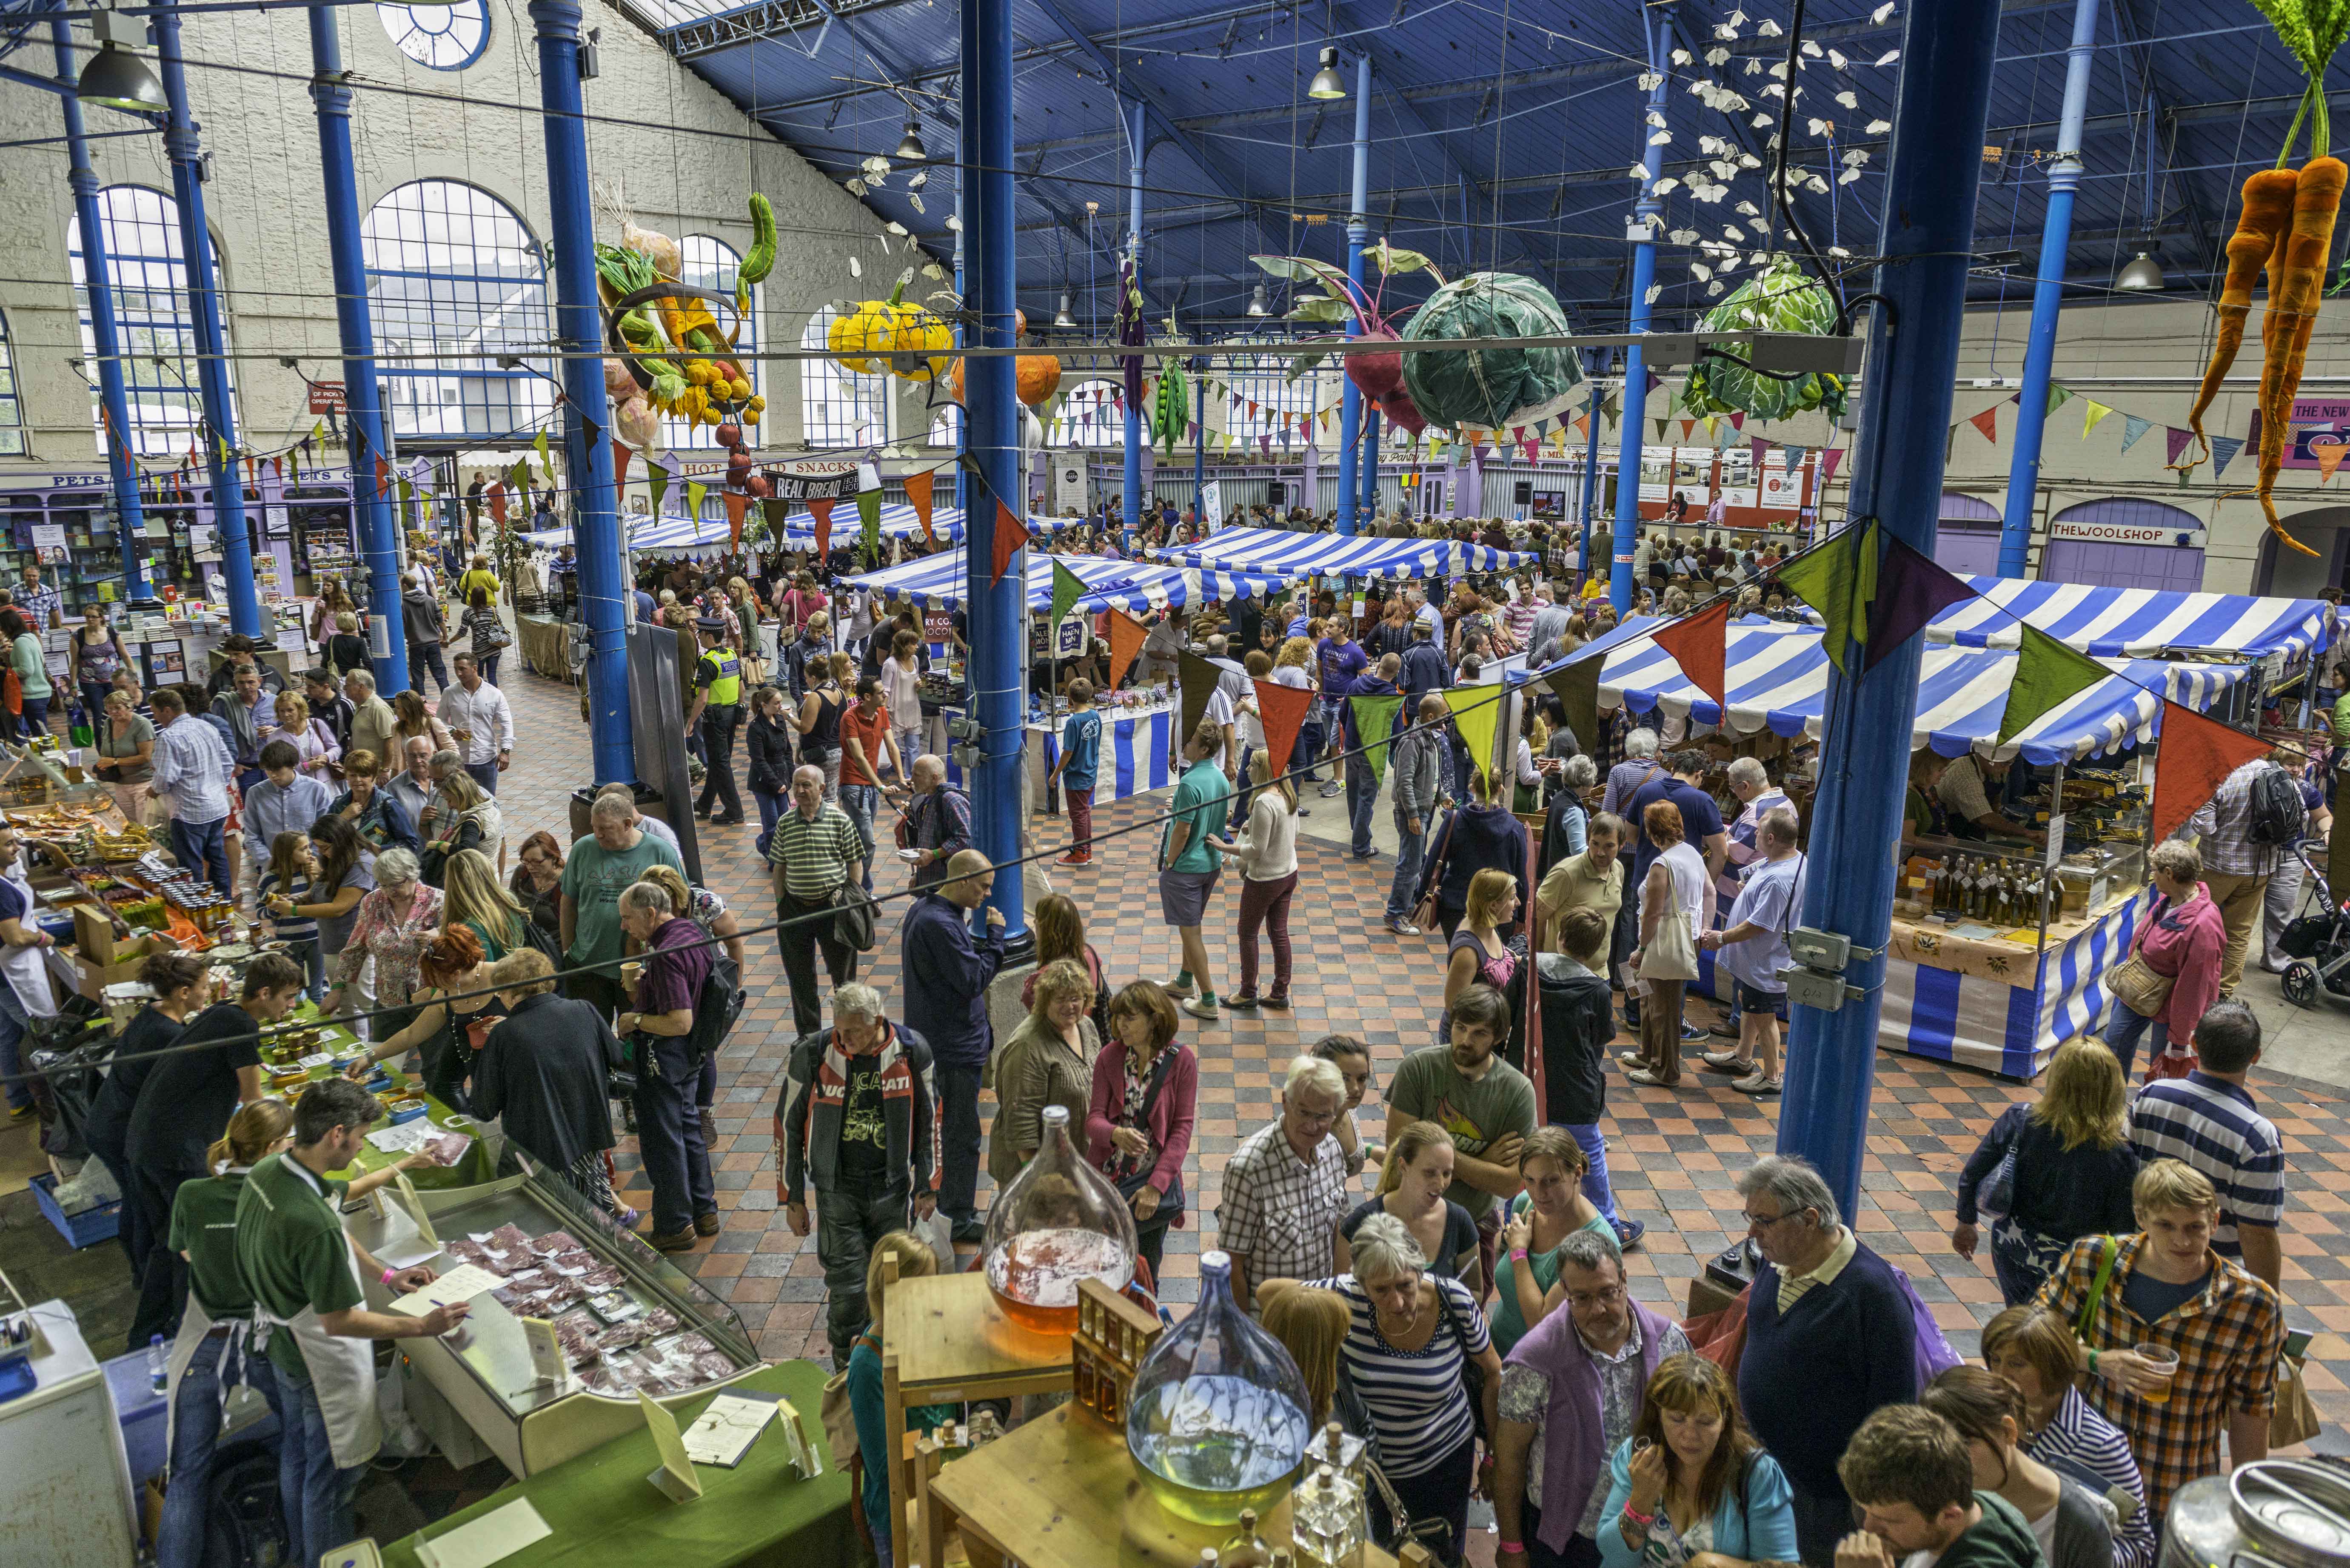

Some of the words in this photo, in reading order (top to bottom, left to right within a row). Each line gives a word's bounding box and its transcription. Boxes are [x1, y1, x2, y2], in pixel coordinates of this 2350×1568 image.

[2296, 405, 2318, 417] THE
[2321, 406, 2350, 417] NEW
[685, 464, 722, 474] HOT
[796, 462, 856, 473] SNACKS
[53, 476, 105, 486] PETS
[777, 477, 804, 499] REAL
[806, 479, 841, 499] BREAD
[843, 476, 858, 485] HOB
[841, 483, 858, 492] HOU
